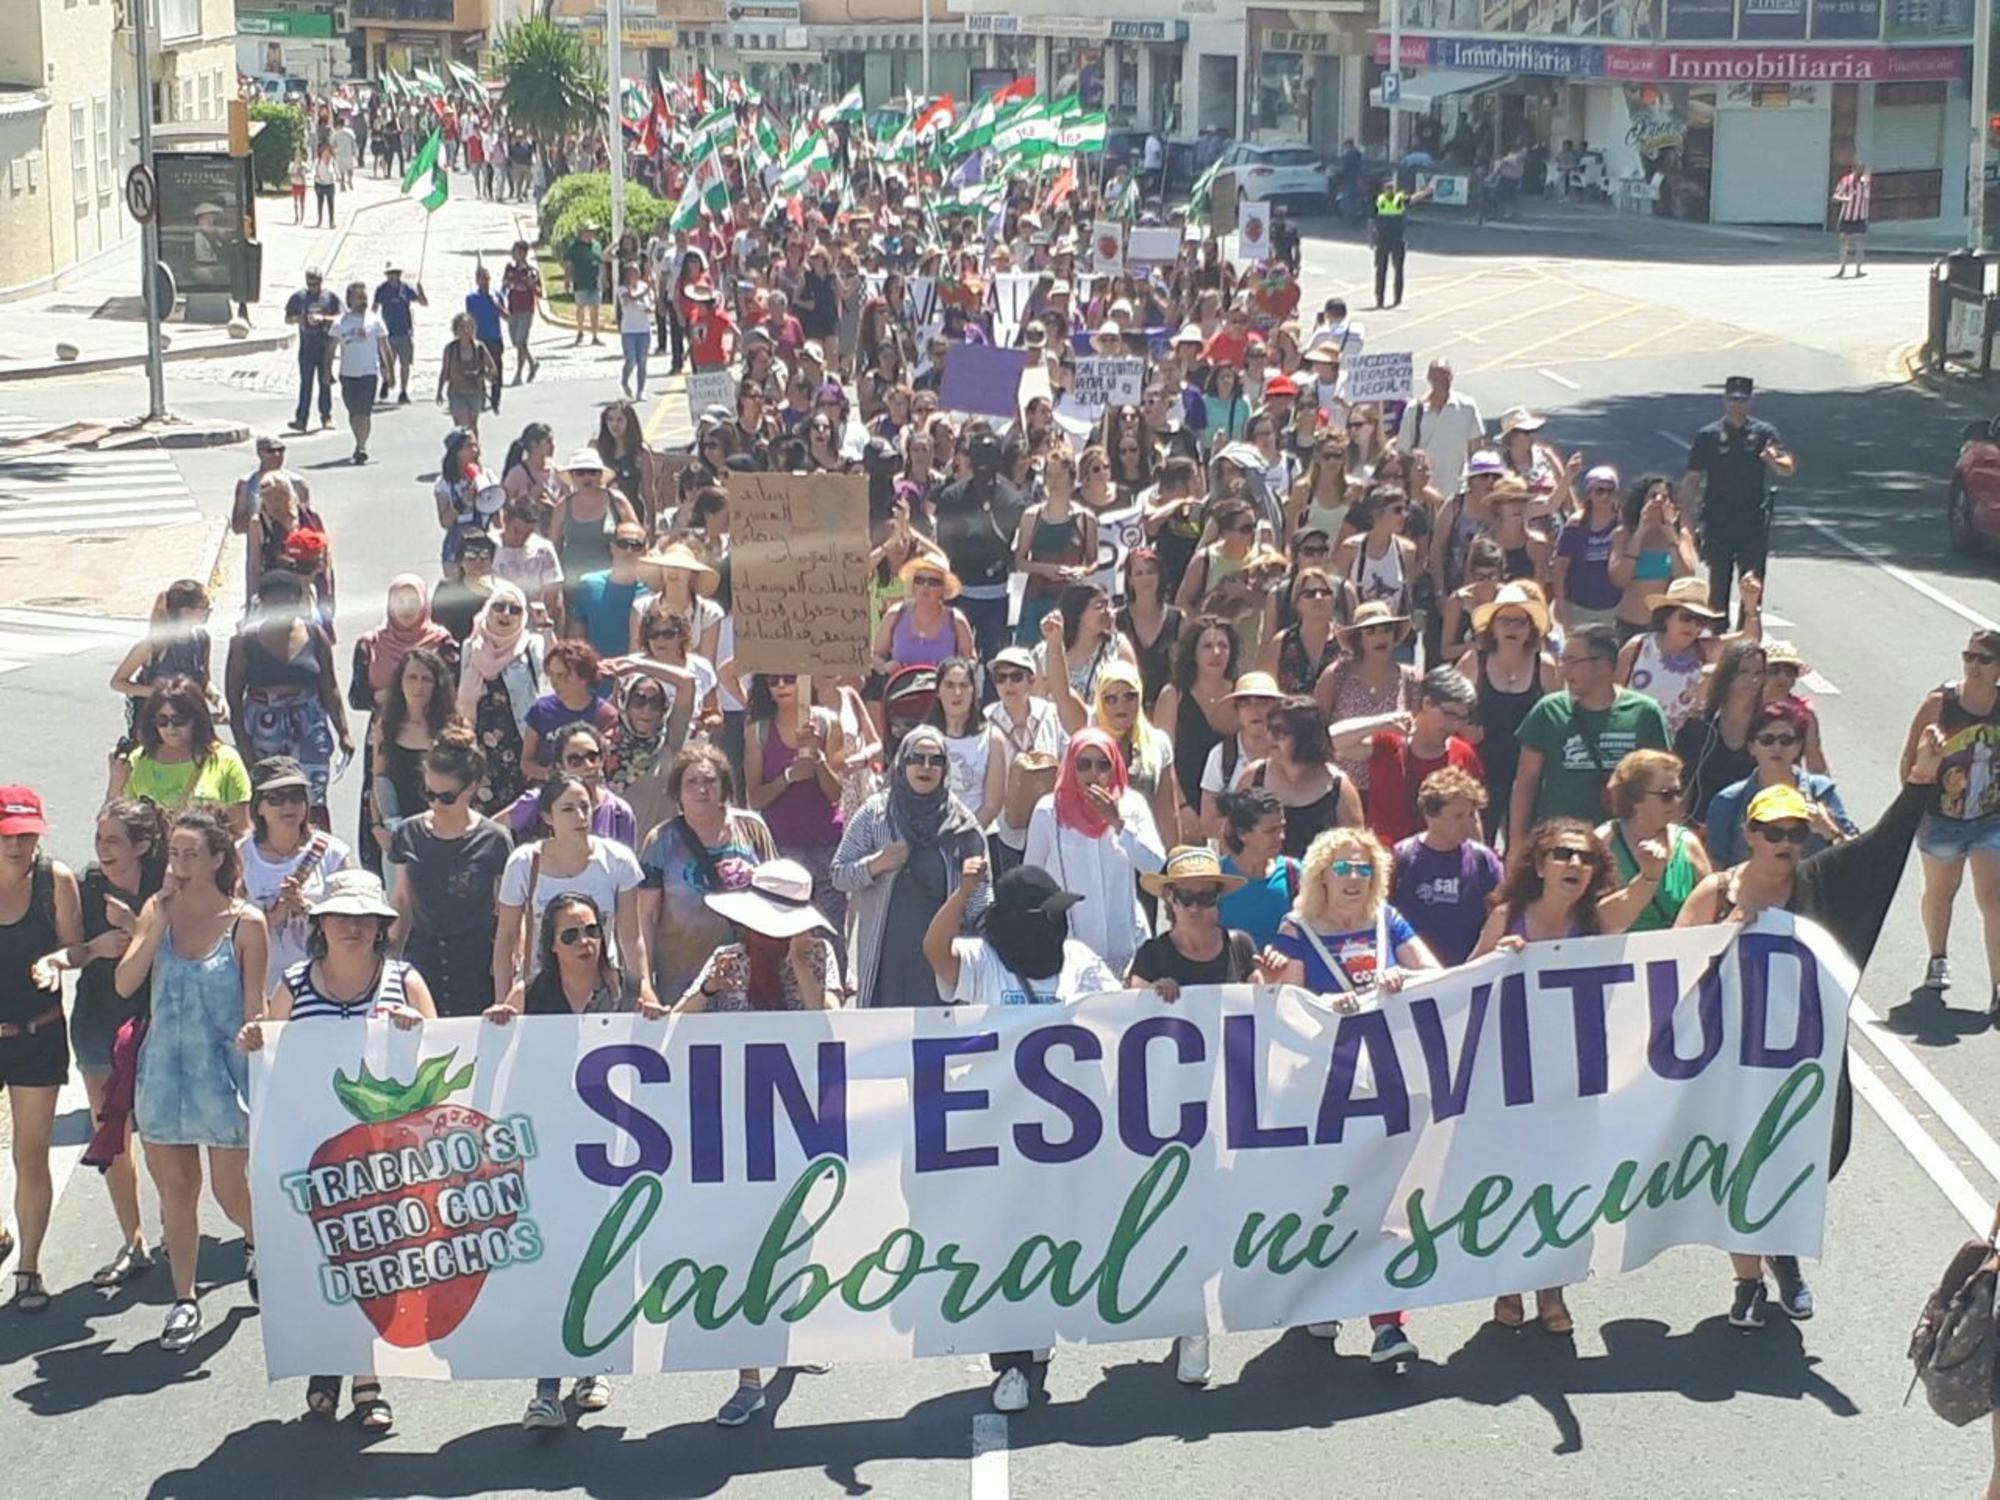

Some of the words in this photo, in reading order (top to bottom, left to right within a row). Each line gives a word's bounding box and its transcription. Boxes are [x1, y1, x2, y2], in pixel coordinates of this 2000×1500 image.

[1384, 75, 1395, 95] P
[575, 1040, 849, 1188] SIN
[912, 933, 1824, 1174] ESCLAVITUD
[284, 1130, 479, 1212] TRABAJO
[484, 1114, 538, 1164] SI
[316, 1199, 430, 1257] PERO
[437, 1171, 531, 1228] CON
[561, 1144, 1189, 1358] laboral
[1232, 1184, 1359, 1275] ni
[1384, 1062, 1824, 1289] sexual
[320, 1218, 544, 1304] DERECHOS
